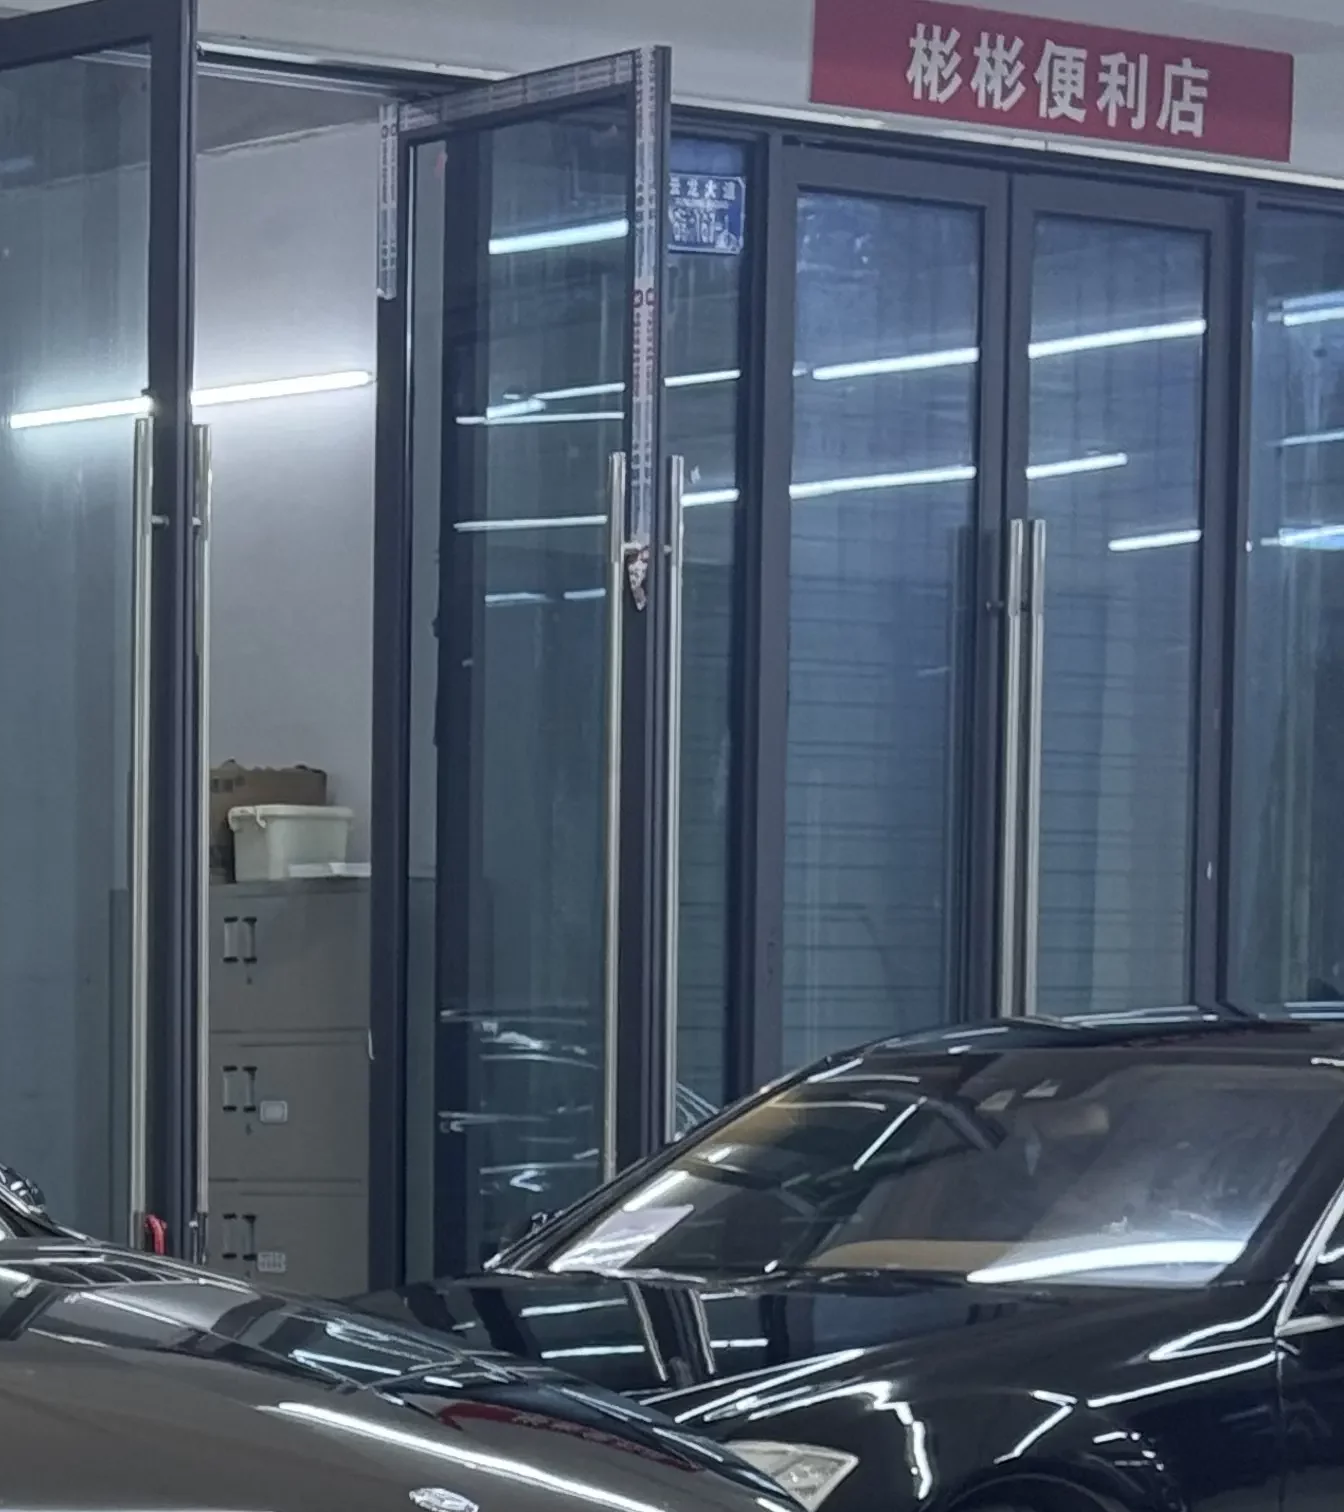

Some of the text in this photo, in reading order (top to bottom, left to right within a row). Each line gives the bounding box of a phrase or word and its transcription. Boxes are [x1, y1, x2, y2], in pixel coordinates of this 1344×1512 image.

[908, 23, 1211, 138] 彬彬便利店
